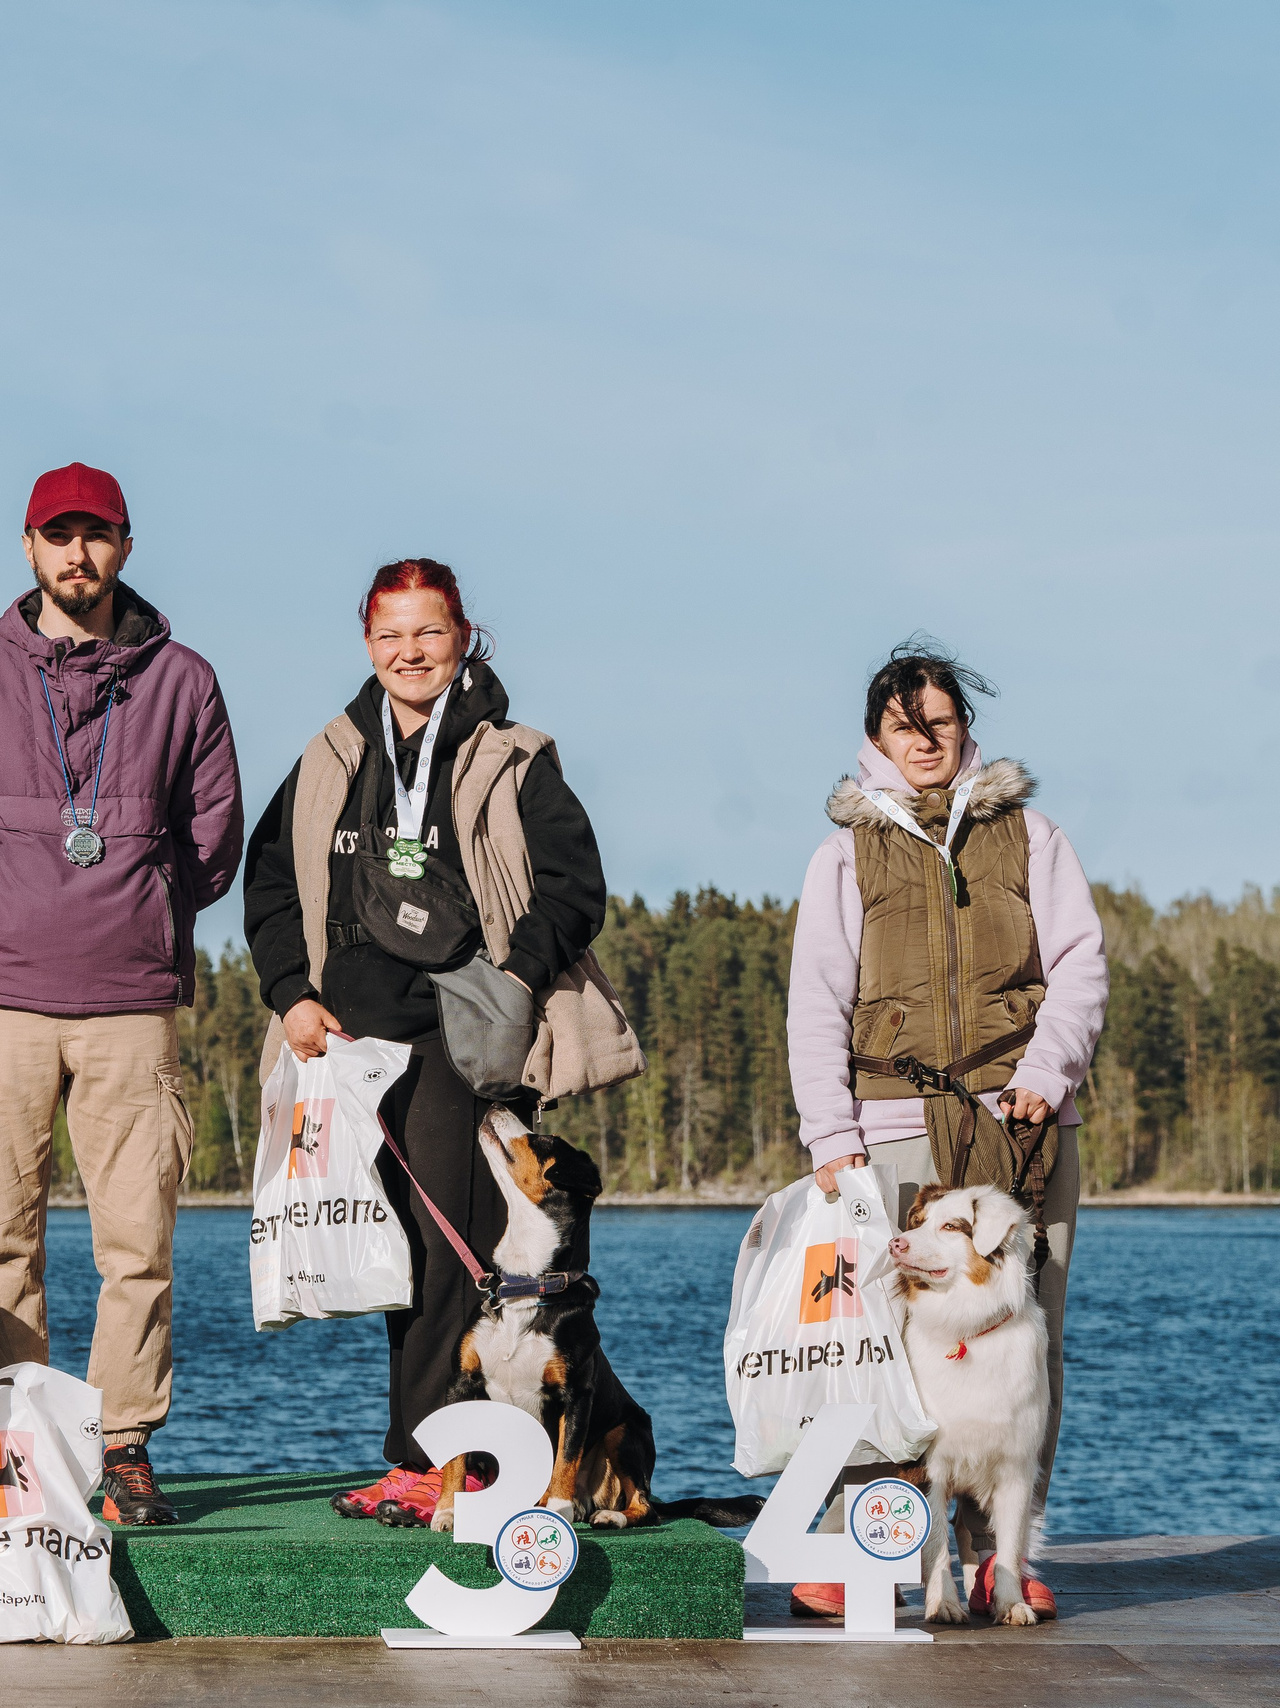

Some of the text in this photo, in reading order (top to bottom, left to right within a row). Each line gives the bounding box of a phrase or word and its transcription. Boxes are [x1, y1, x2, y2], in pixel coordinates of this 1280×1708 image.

[736, 1340, 845, 1380] етыре
[404, 1400, 560, 1636] 3
[742, 1403, 922, 1633] 4
